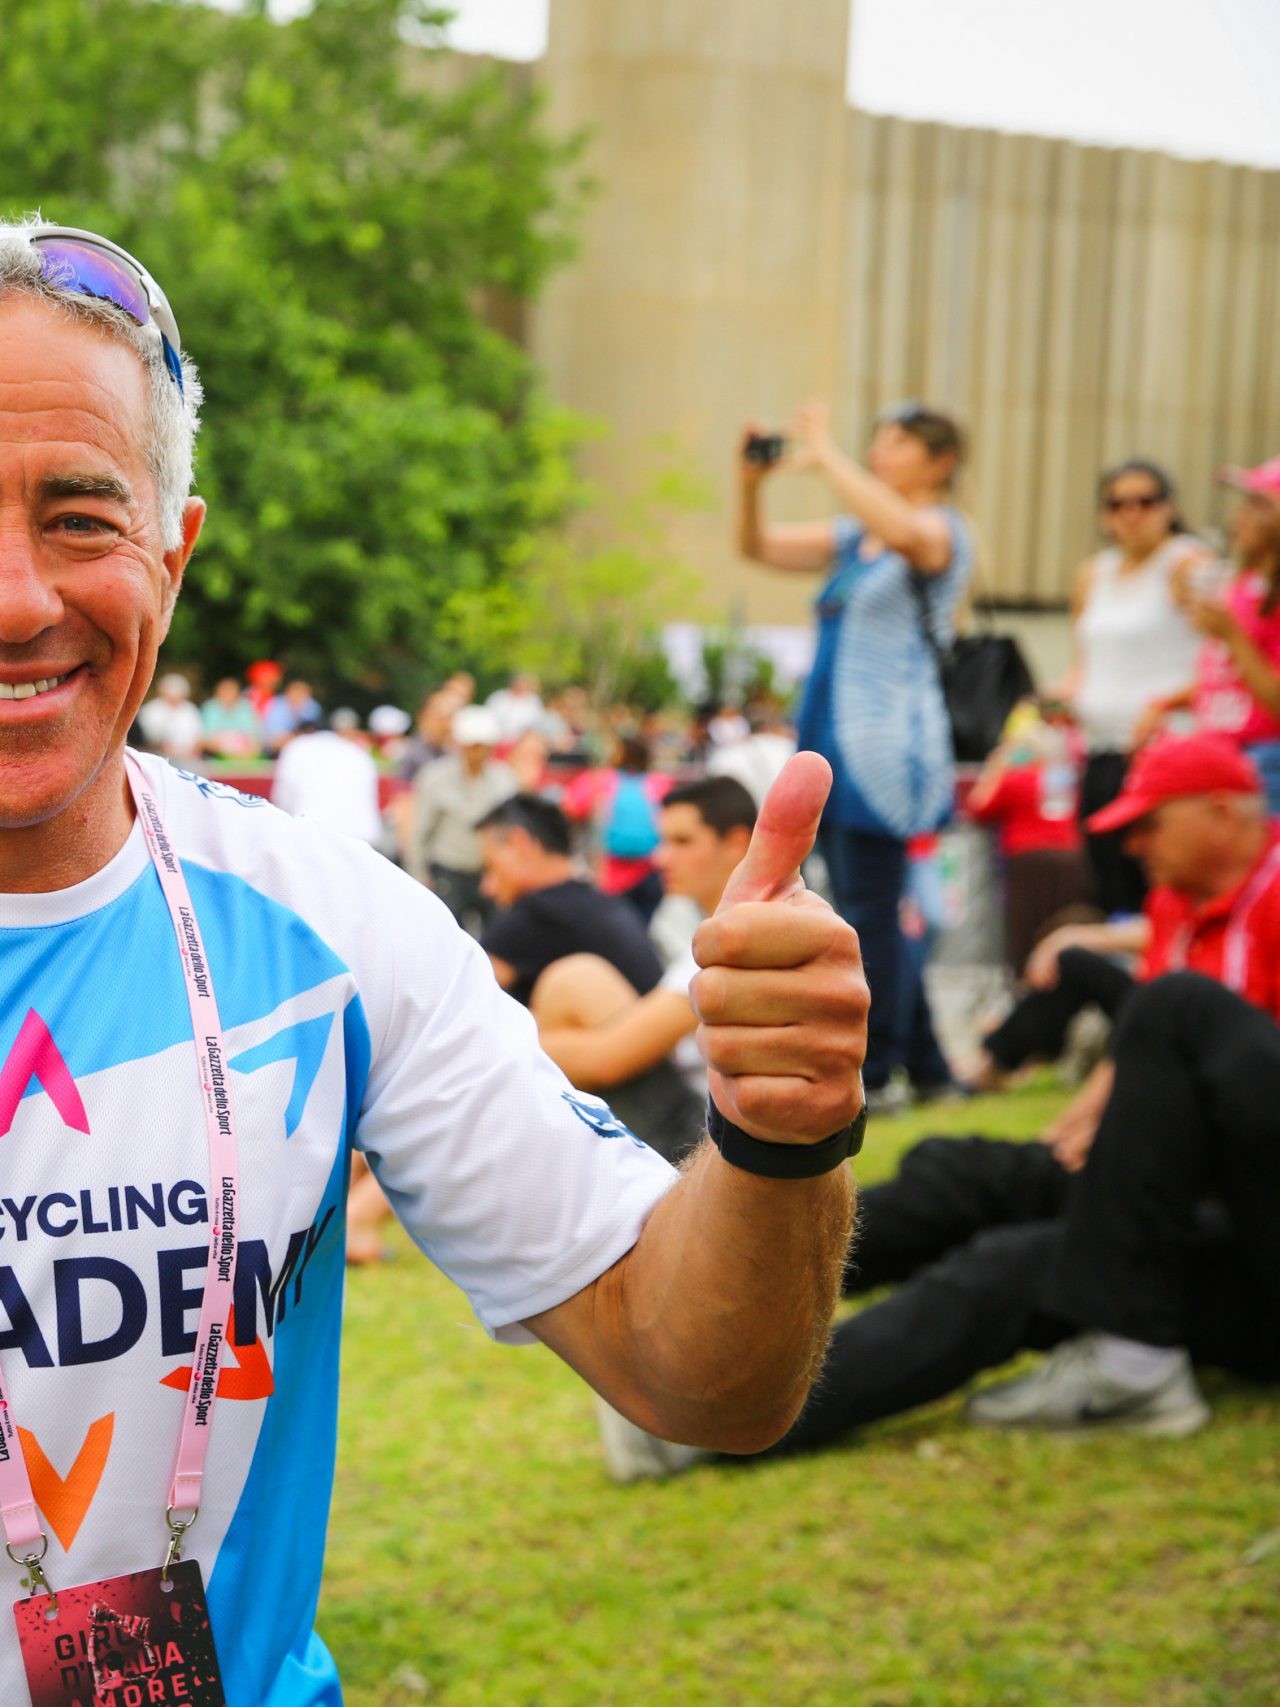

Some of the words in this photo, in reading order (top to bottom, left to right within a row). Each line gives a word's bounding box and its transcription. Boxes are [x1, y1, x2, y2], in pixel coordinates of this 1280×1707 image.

[214, 1087, 228, 1109] dello
[216, 1110, 232, 1135] Sport
[221, 1231, 234, 1254] dello
[217, 1255, 232, 1282] Sport
[199, 1377, 215, 1399] dello
[195, 1400, 211, 1426] Sport
[60, 1641, 185, 1688] D'IALIA
